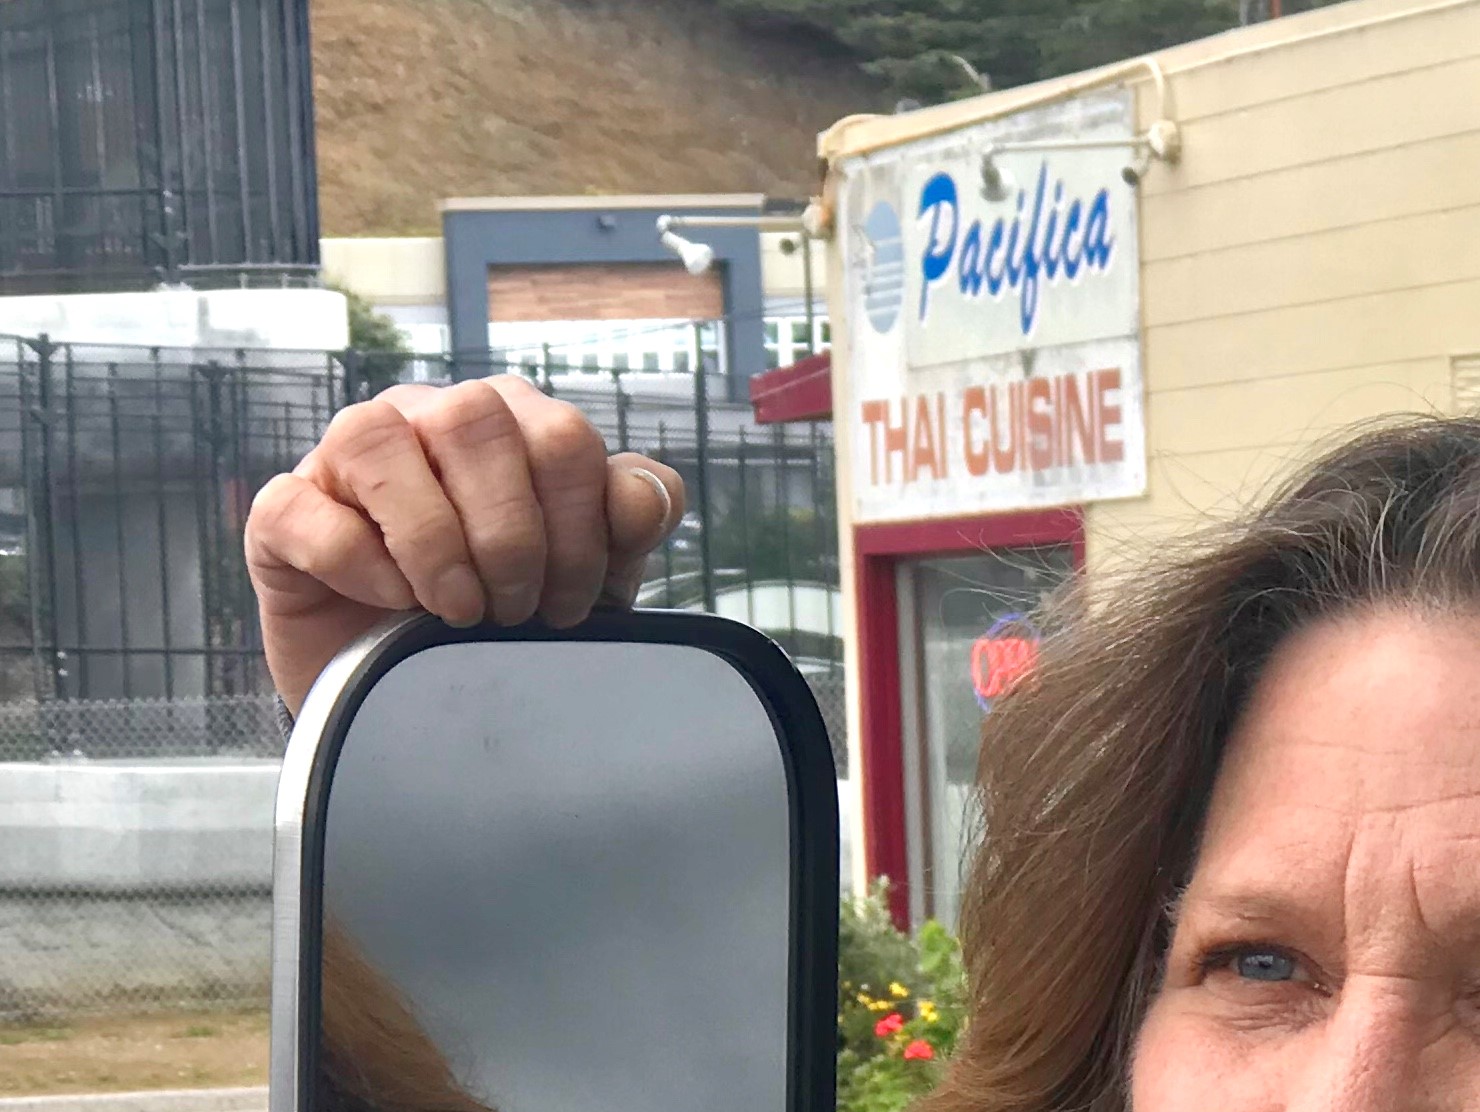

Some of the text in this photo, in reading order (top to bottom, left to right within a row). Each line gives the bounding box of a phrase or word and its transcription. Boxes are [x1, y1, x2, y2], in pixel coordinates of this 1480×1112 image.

[917, 158, 1114, 335] Pacifica
[861, 367, 1125, 486] THAI CUISINE
